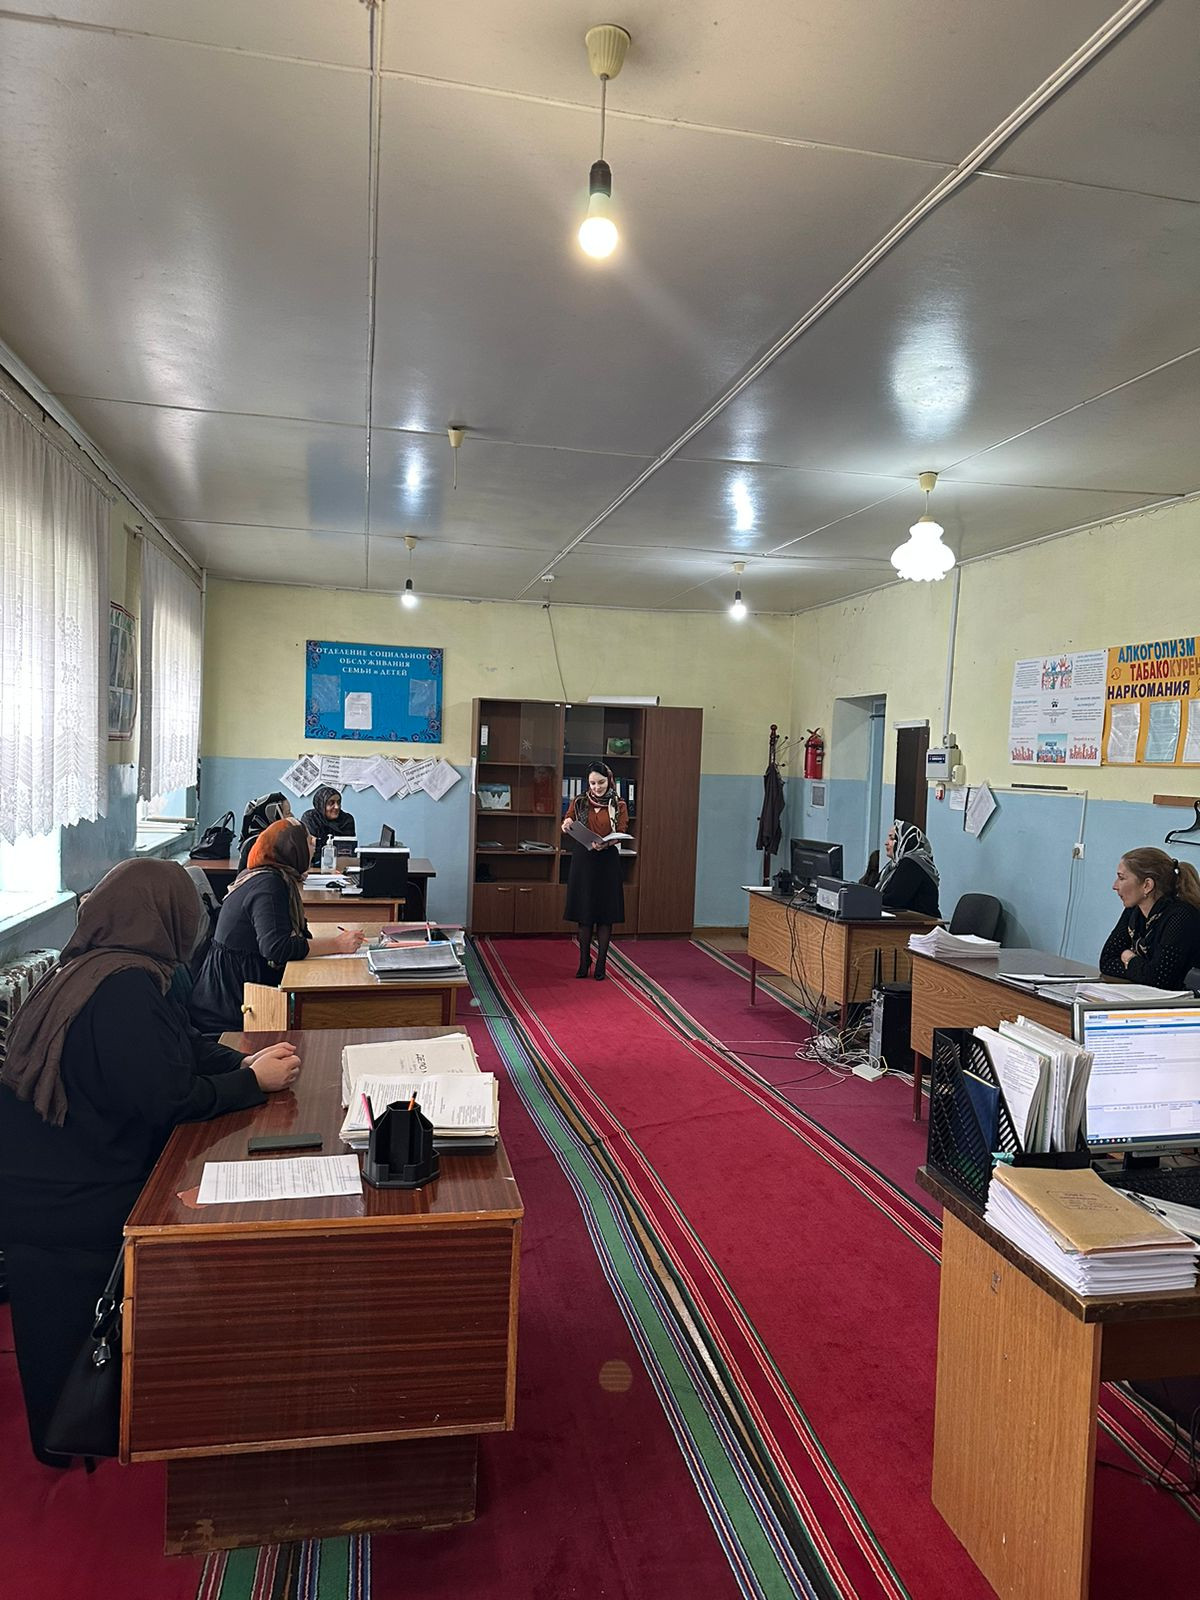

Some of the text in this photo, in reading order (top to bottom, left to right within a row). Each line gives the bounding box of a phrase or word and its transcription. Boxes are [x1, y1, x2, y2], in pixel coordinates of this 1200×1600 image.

[316, 647, 433, 660] ОТДЕЛЕНИЕ СОЦИАЛЬНОГО
[1118, 638, 1195, 663] АЛКОГОЛИЗМ
[339, 657, 410, 668] ОБСЛУЖИВАНИЯ
[342, 667, 372, 675] СЕМЬИ
[380, 668, 408, 676] ДЕТЕЙ
[1107, 680, 1190, 700] НАРКОМАНИЯ
